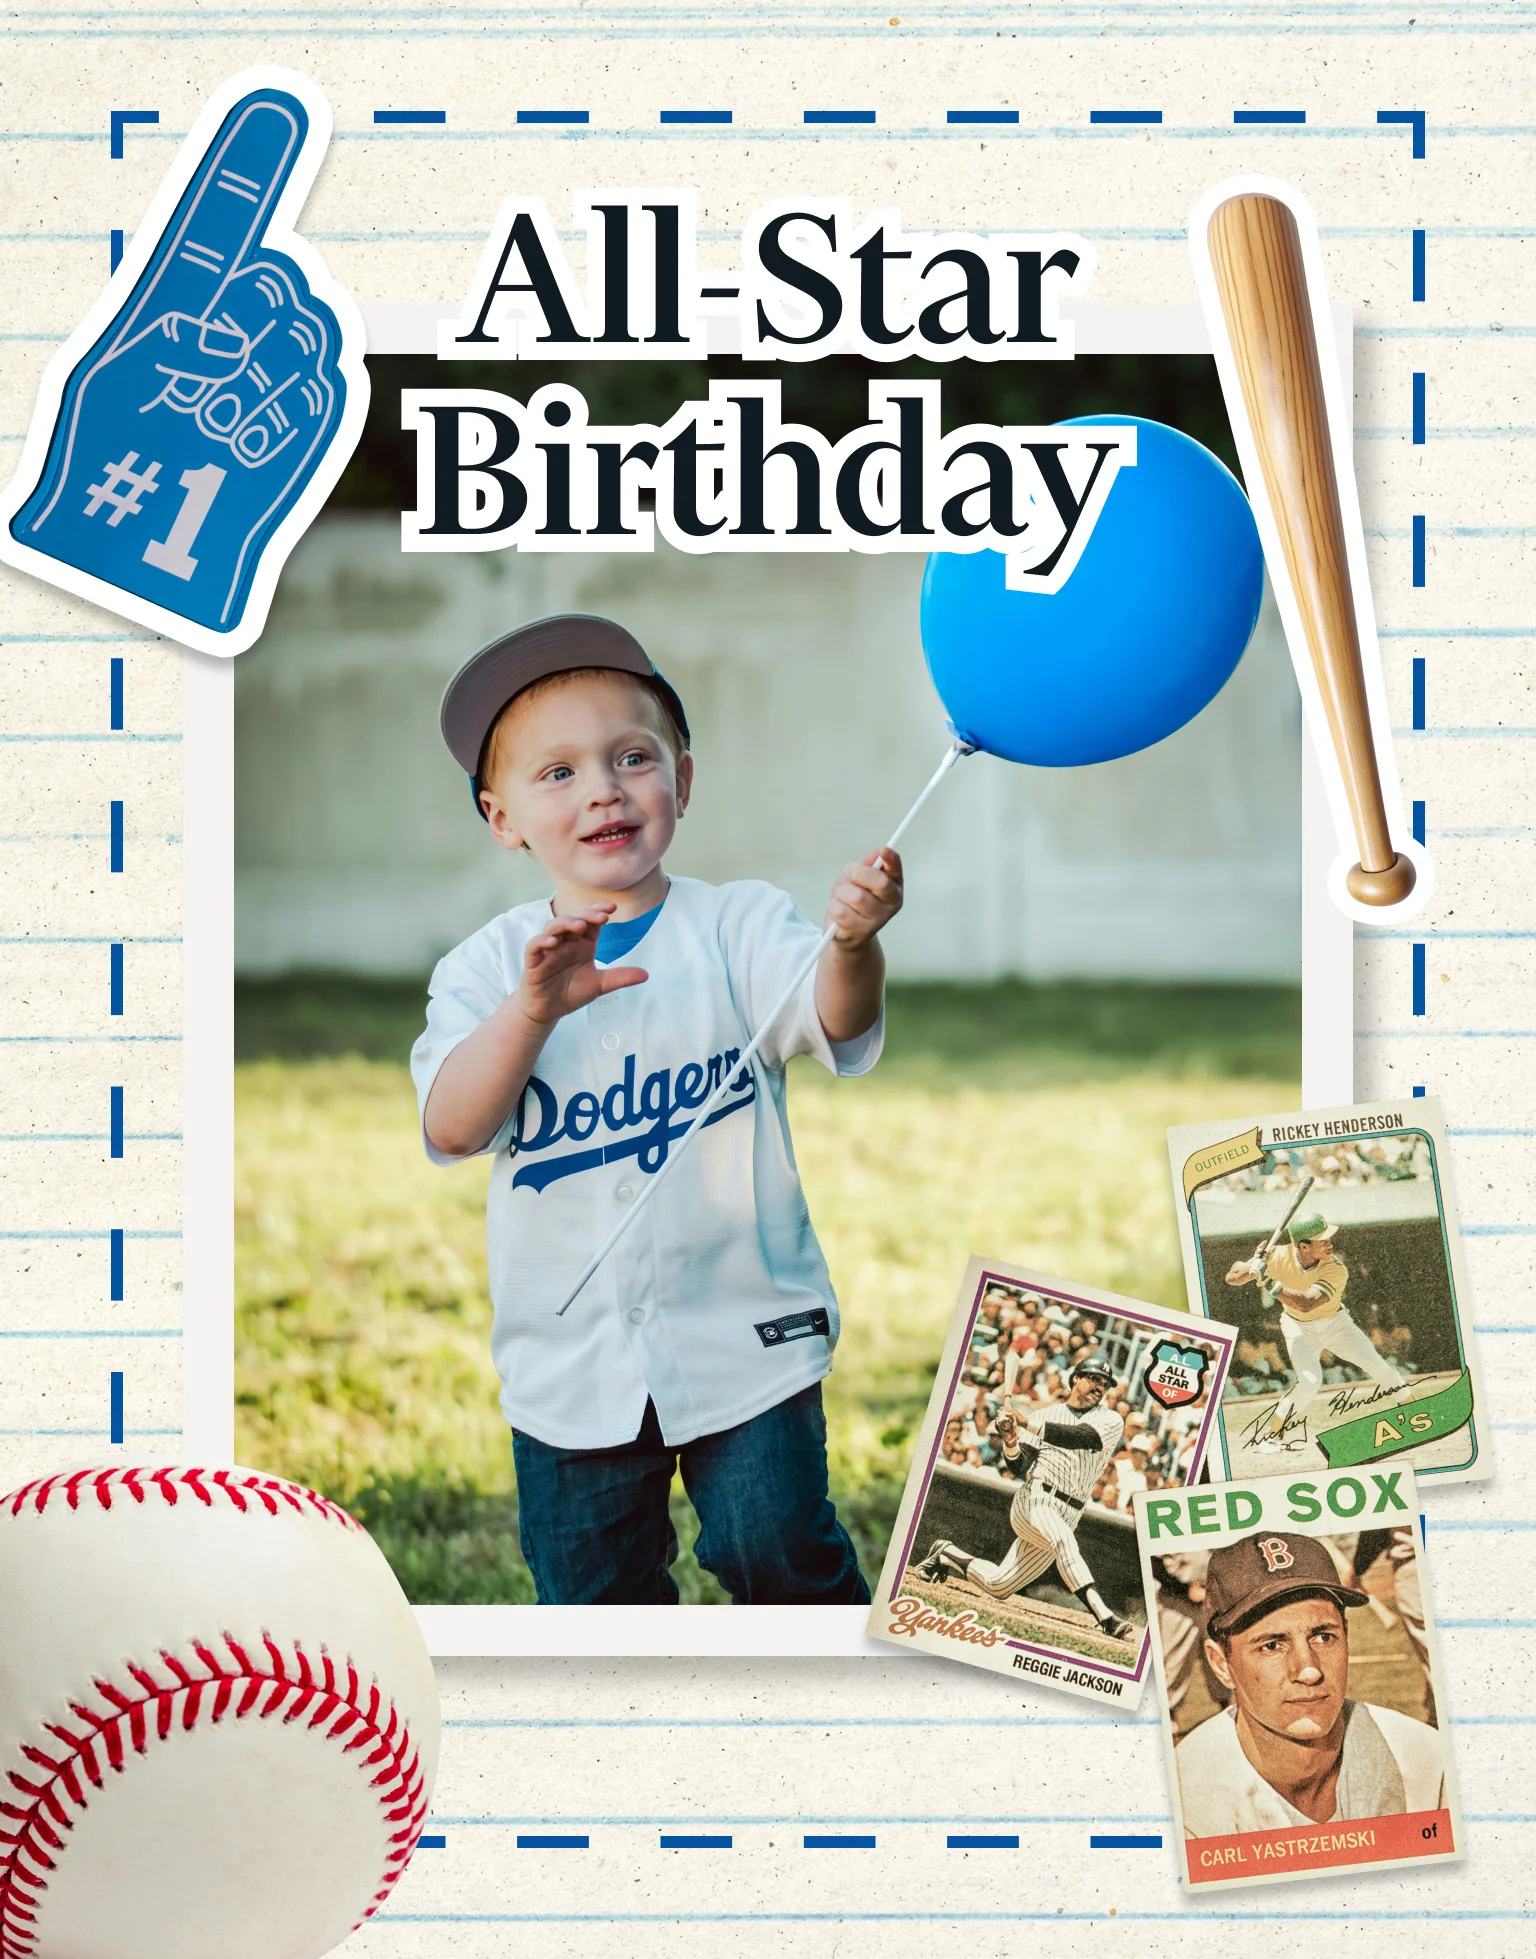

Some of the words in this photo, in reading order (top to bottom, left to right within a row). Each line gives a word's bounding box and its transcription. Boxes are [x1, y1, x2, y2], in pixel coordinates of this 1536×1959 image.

[83, 450, 227, 582] #1
[510, 1047, 756, 1174] Dodgers
[1272, 1122, 1320, 1142] RICKEY
[1323, 1113, 1404, 1136] HENDERSON
[1194, 1143, 1250, 1173] OUTFIELD
[1164, 1365, 1188, 1379] ALL
[1169, 1353, 1191, 1367] A.L.
[1157, 1374, 1190, 1390] STAR
[1161, 1388, 1179, 1399] OF
[1328, 1375, 1437, 1417] Henderson
[1373, 1412, 1434, 1449] A's
[1146, 1490, 1263, 1539] RED
[1286, 1471, 1409, 1523] SOX
[1258, 1537, 1294, 1572] B
[888, 1598, 1006, 1648] Yankees
[1012, 1654, 1063, 1680] REGGIE
[1062, 1669, 1124, 1697] JACKSON
[1200, 1846, 1247, 1867] CARL
[1251, 1830, 1376, 1861] YASTRZEMSKI
[1421, 1823, 1438, 1840] of
